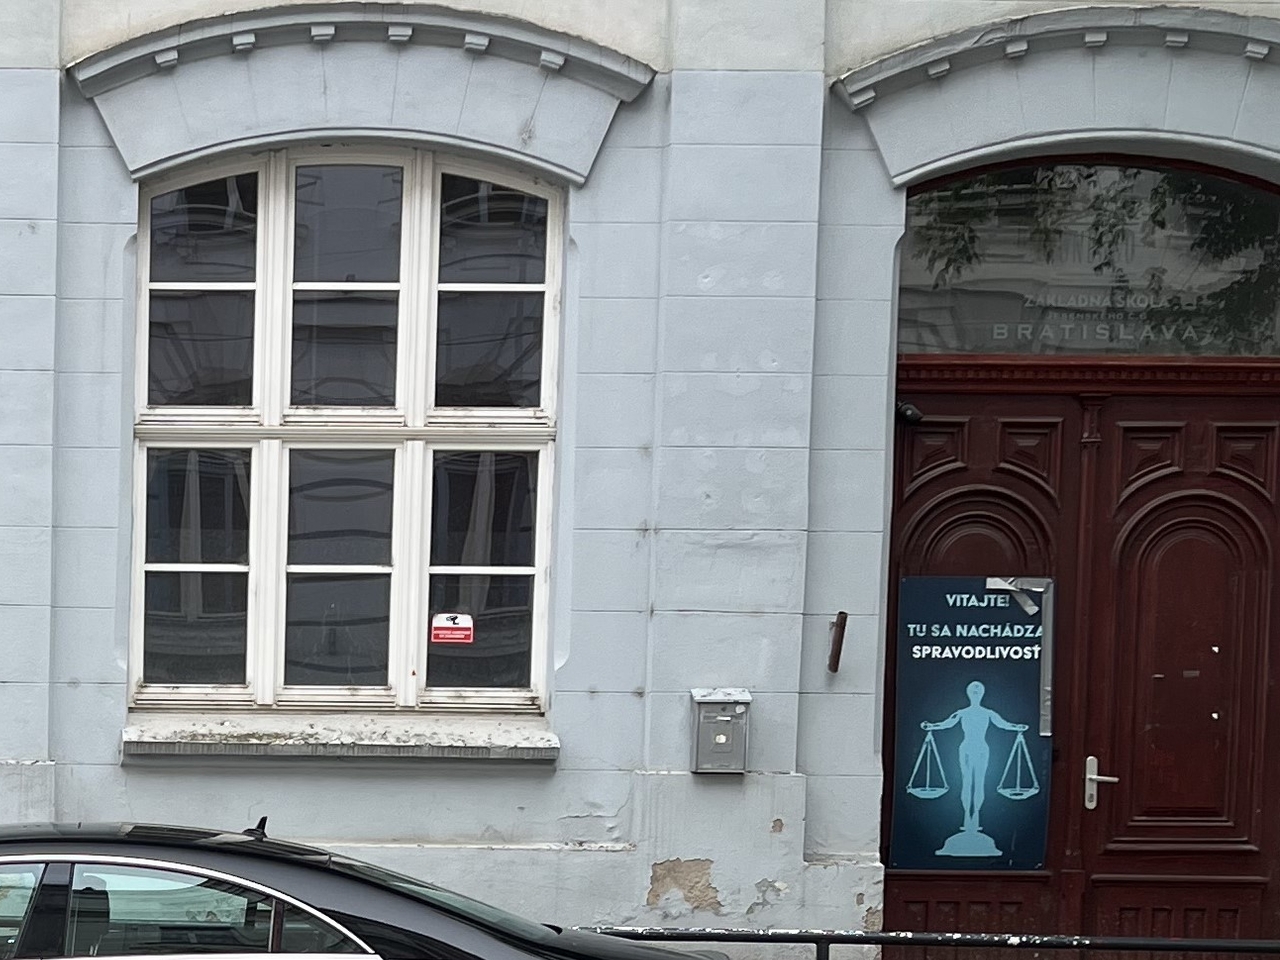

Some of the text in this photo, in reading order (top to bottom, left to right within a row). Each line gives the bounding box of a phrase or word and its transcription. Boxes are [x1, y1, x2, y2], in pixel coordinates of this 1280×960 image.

[993, 324, 1199, 341] BRATISLAVA
[945, 594, 1010, 607] VITAJTE!
[908, 624, 926, 637] TU
[931, 624, 952, 637] SA
